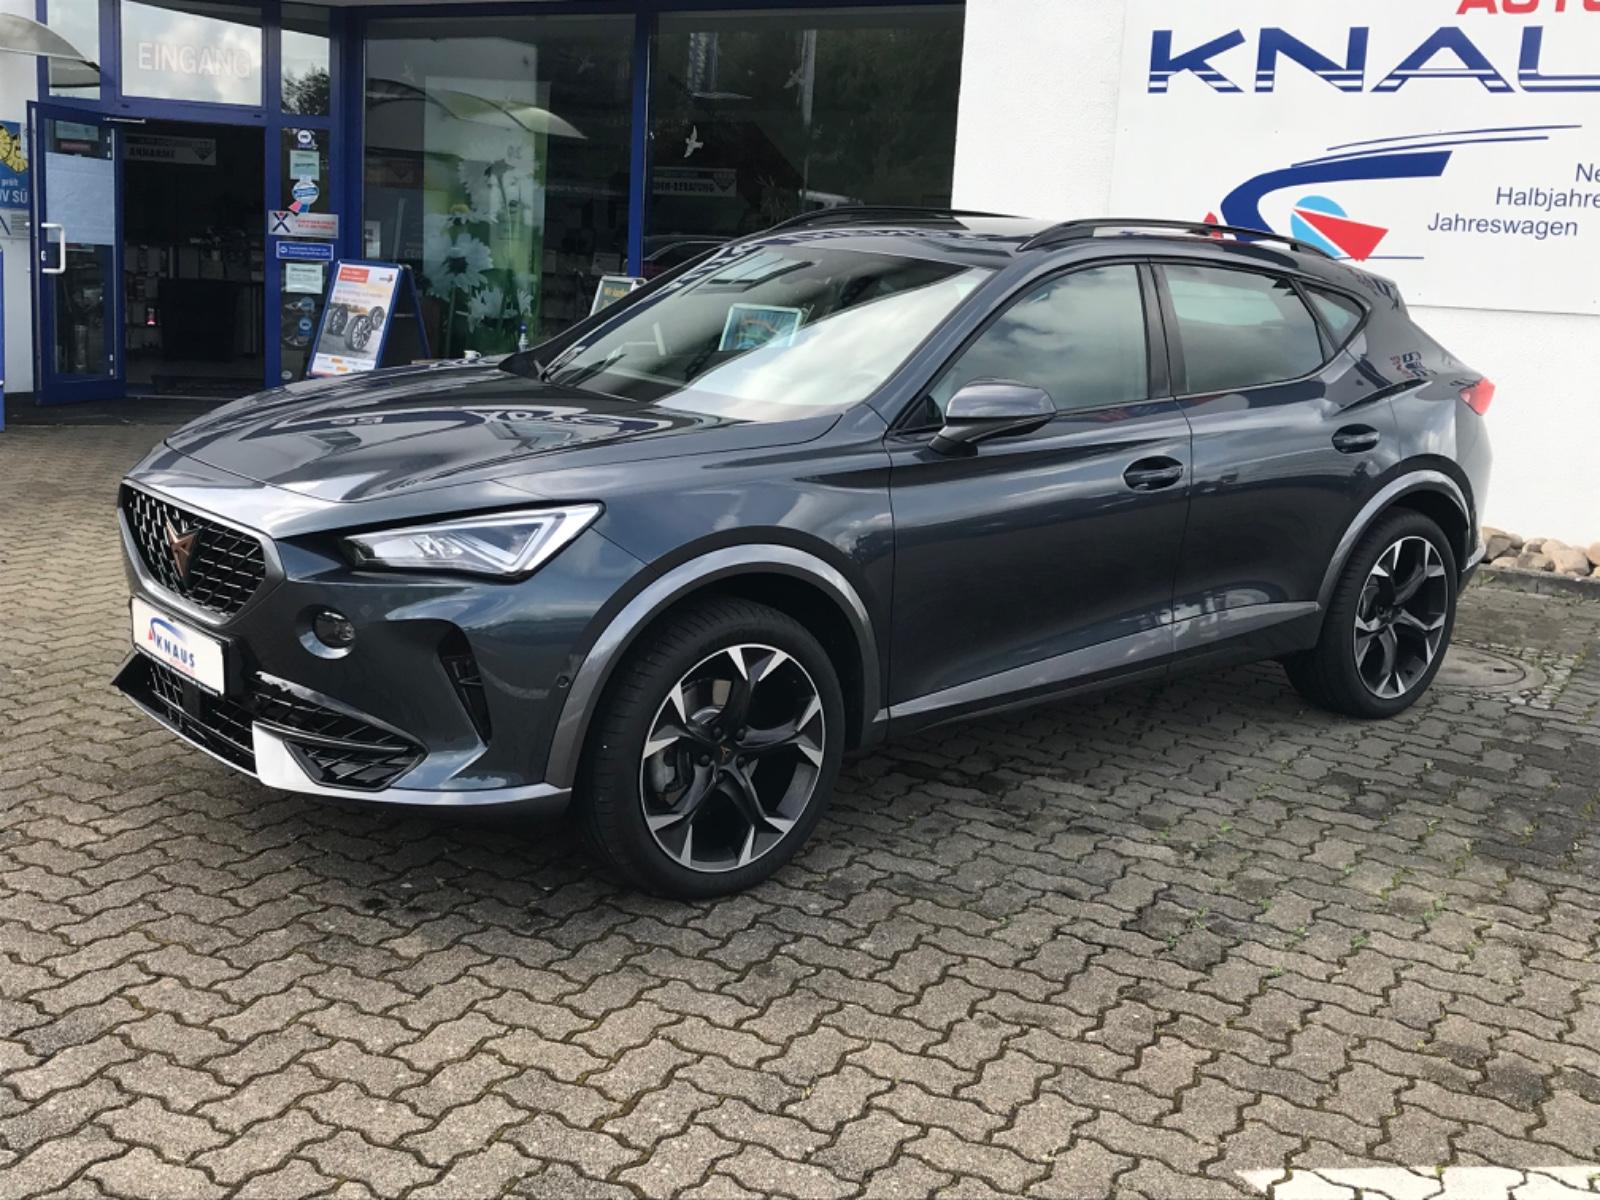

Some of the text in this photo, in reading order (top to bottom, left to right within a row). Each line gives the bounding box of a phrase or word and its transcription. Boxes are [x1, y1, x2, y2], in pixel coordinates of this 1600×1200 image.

[138, 42, 251, 79] EINGANG
[0, 189, 9, 203] V
[1495, 186, 1600, 212] Halbjahre
[1428, 212, 1578, 241] Jahreswagen
[156, 633, 196, 668] KNAUS
